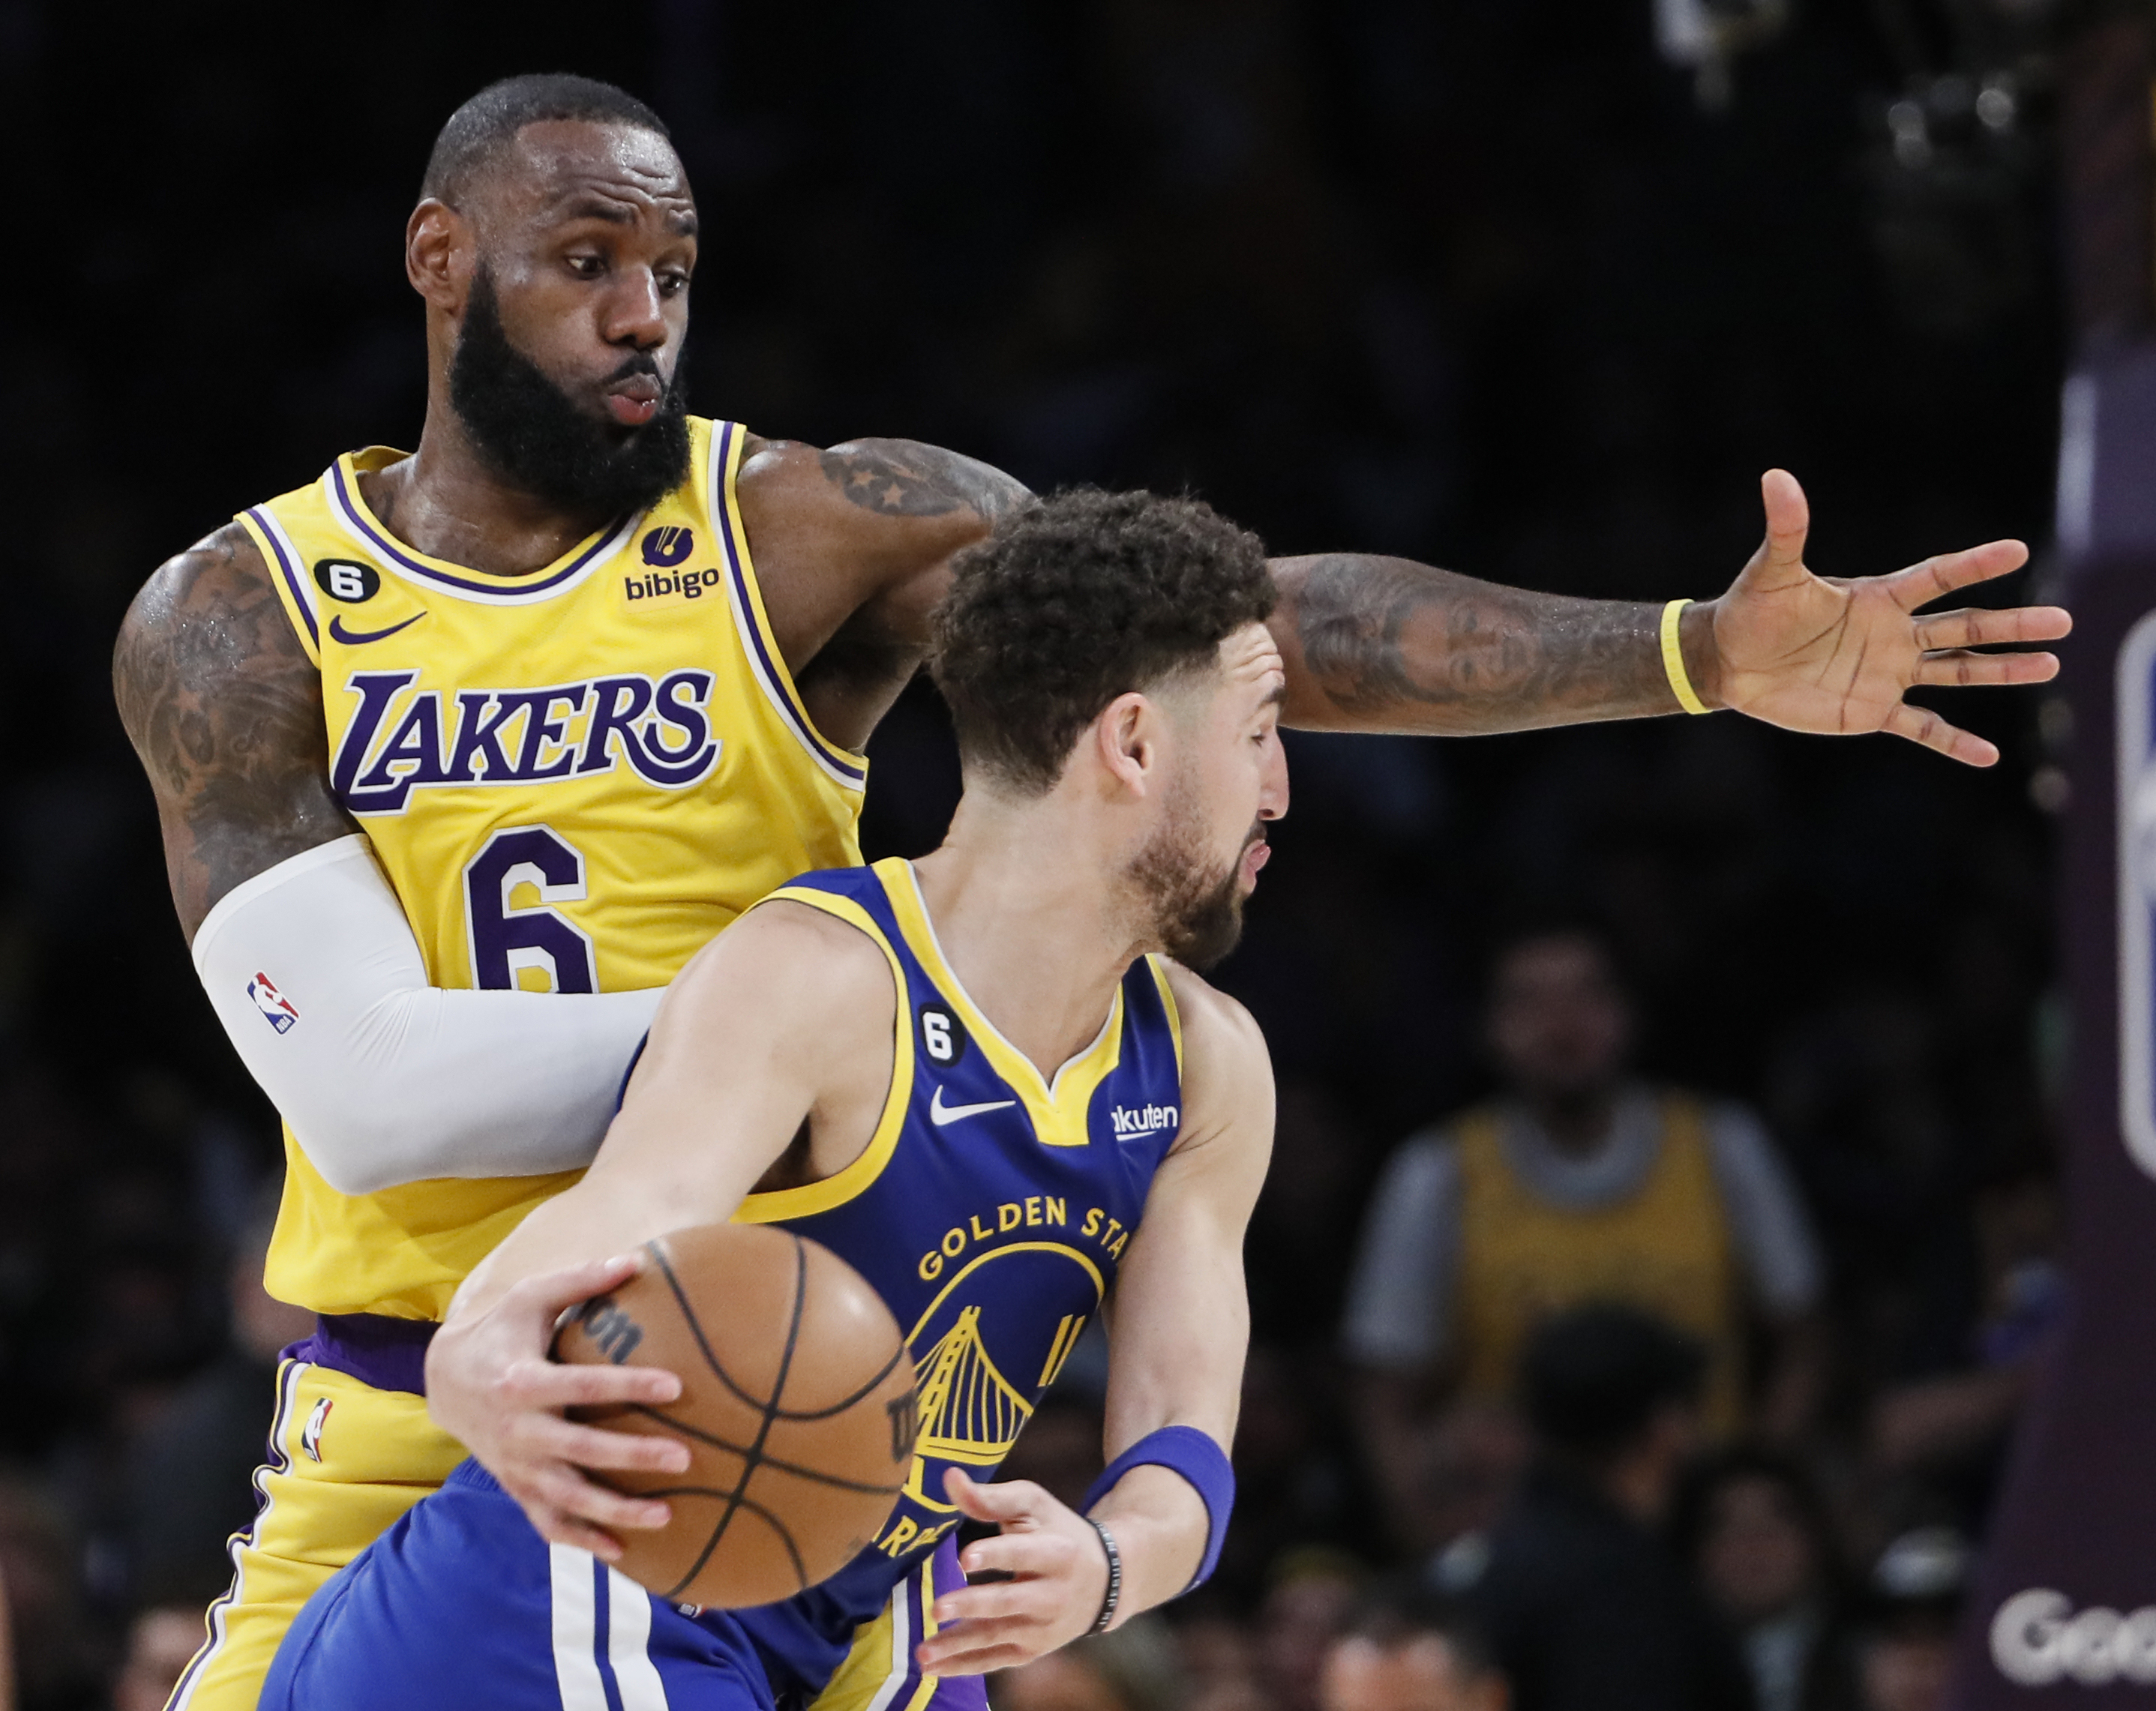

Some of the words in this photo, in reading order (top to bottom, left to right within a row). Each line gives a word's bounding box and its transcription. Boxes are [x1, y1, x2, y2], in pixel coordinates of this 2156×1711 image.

[329, 565, 364, 598] 6
[624, 567, 720, 601] bibigo
[329, 667, 723, 817] LAKERS
[462, 821, 601, 994] 6
[275, 1014, 292, 1033] NBA
[922, 1011, 952, 1061] 6
[918, 1195, 1066, 1281] GOLDEN
